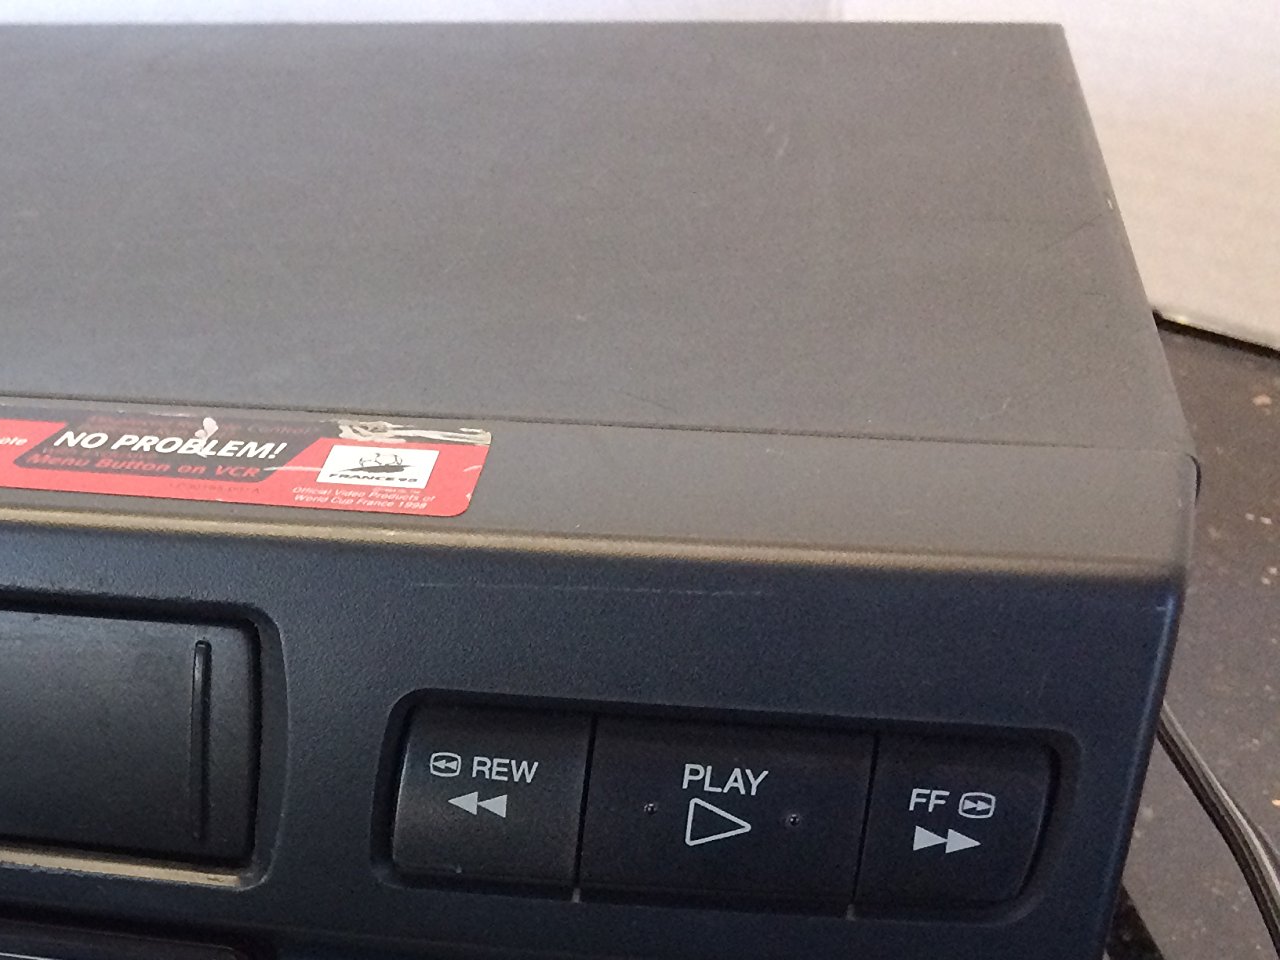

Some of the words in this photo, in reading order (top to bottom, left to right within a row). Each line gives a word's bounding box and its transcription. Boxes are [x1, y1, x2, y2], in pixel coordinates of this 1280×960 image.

[53, 431, 109, 450] NO
[110, 434, 288, 459] PROBLEM!
[93, 458, 171, 473] Button
[176, 465, 208, 475] on
[214, 464, 263, 478] VCR
[294, 494, 329, 504] World
[330, 497, 355, 506] Cup
[356, 498, 396, 508] France
[334, 489, 367, 498] Video
[368, 490, 420, 503] Products
[471, 756, 539, 785] REW
[682, 764, 769, 797] PLAY
[908, 788, 951, 813] FF
